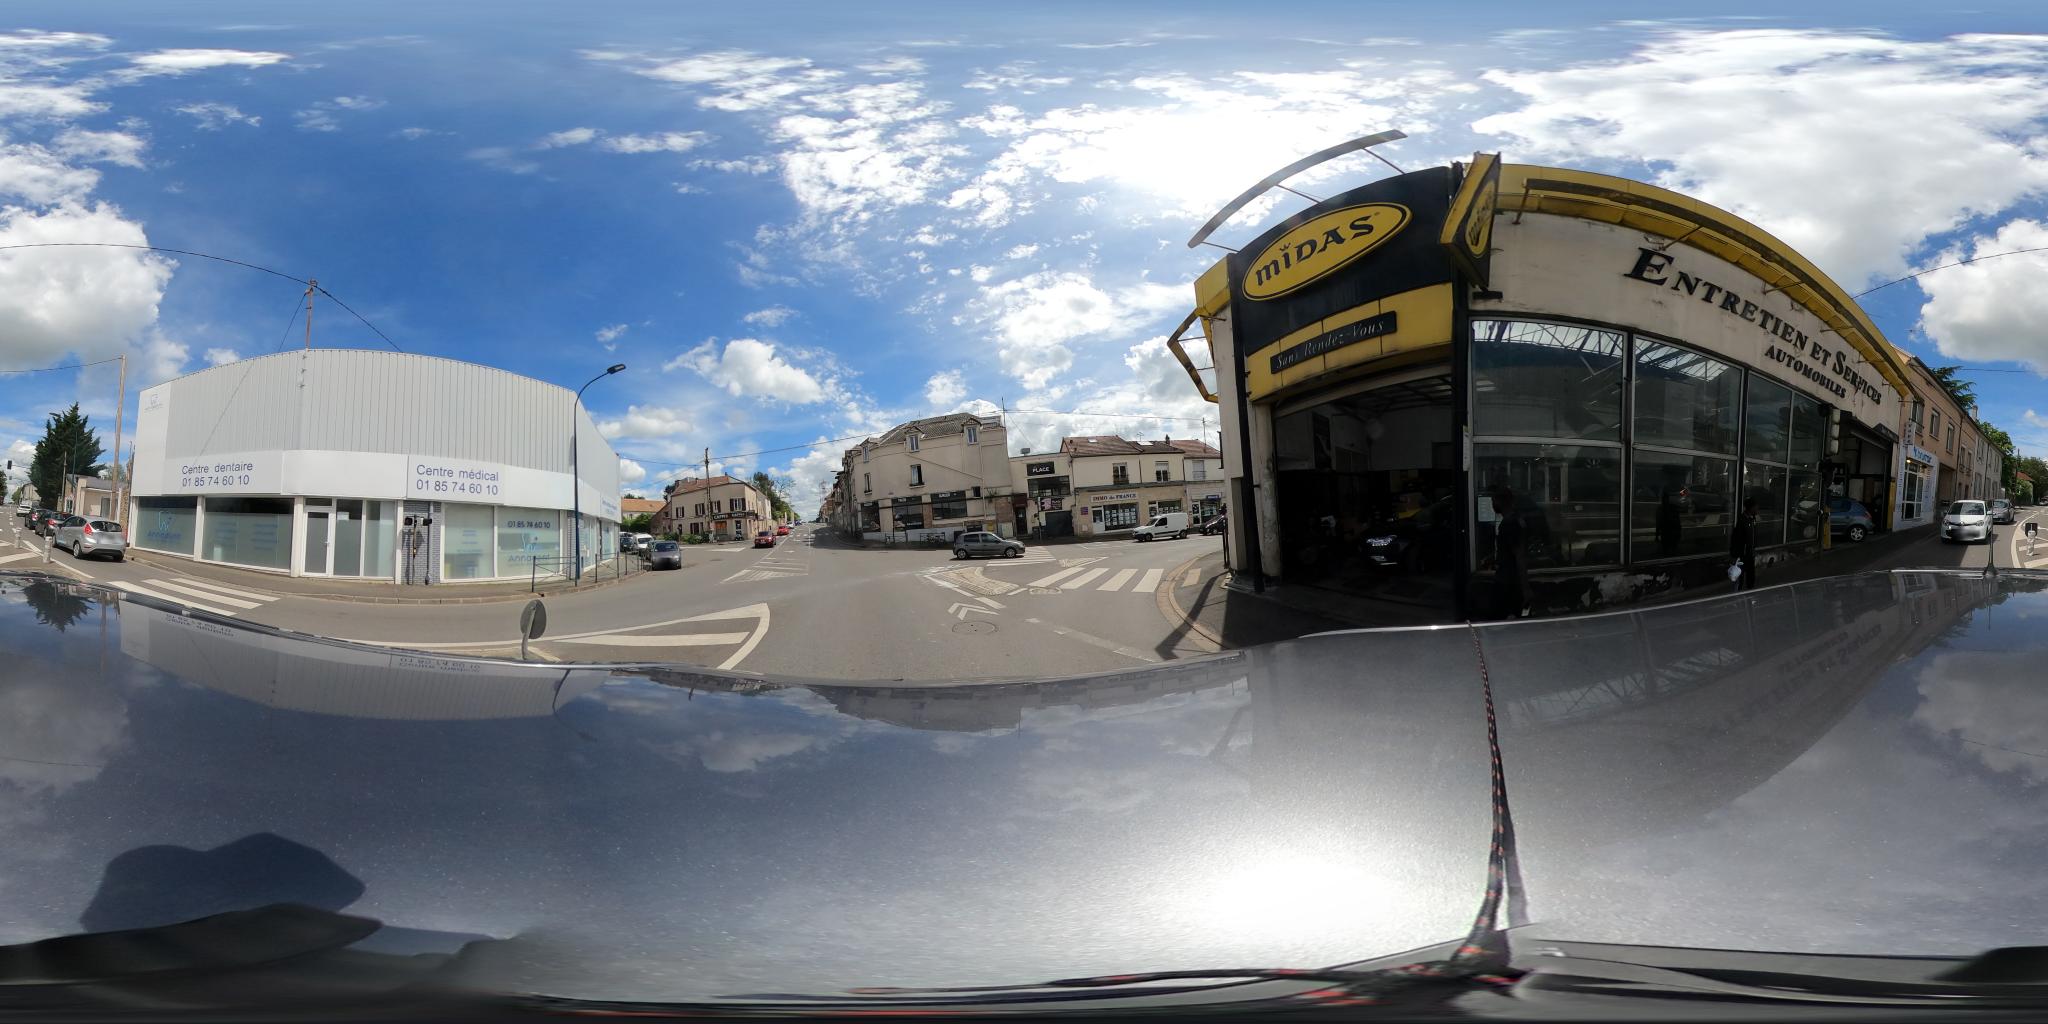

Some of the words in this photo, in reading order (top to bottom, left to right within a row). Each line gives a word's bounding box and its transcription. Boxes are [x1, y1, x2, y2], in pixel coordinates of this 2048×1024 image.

[1255, 215, 1374, 286] MIDAS
[1623, 247, 1809, 351] ENTRETIEN
[1809, 341, 1832, 366] ET
[1832, 350, 1882, 405] SERVICES
[1764, 344, 1847, 399] AUTOMOBILES
[181, 465, 209, 475] Centre
[214, 462, 253, 473] dentaire
[416, 464, 454, 477] Centre
[458, 469, 499, 481] médical
[182, 477, 191, 487] 01
[194, 477, 205, 486] 85
[208, 476, 219, 486] 74
[222, 475, 234, 485] 60
[238, 474, 250, 485] 10
[416, 479, 429, 490] 01
[434, 480, 448, 491] 85
[452, 481, 466, 493] 74
[469, 483, 482, 494] 60
[486, 485, 498, 495] 10
